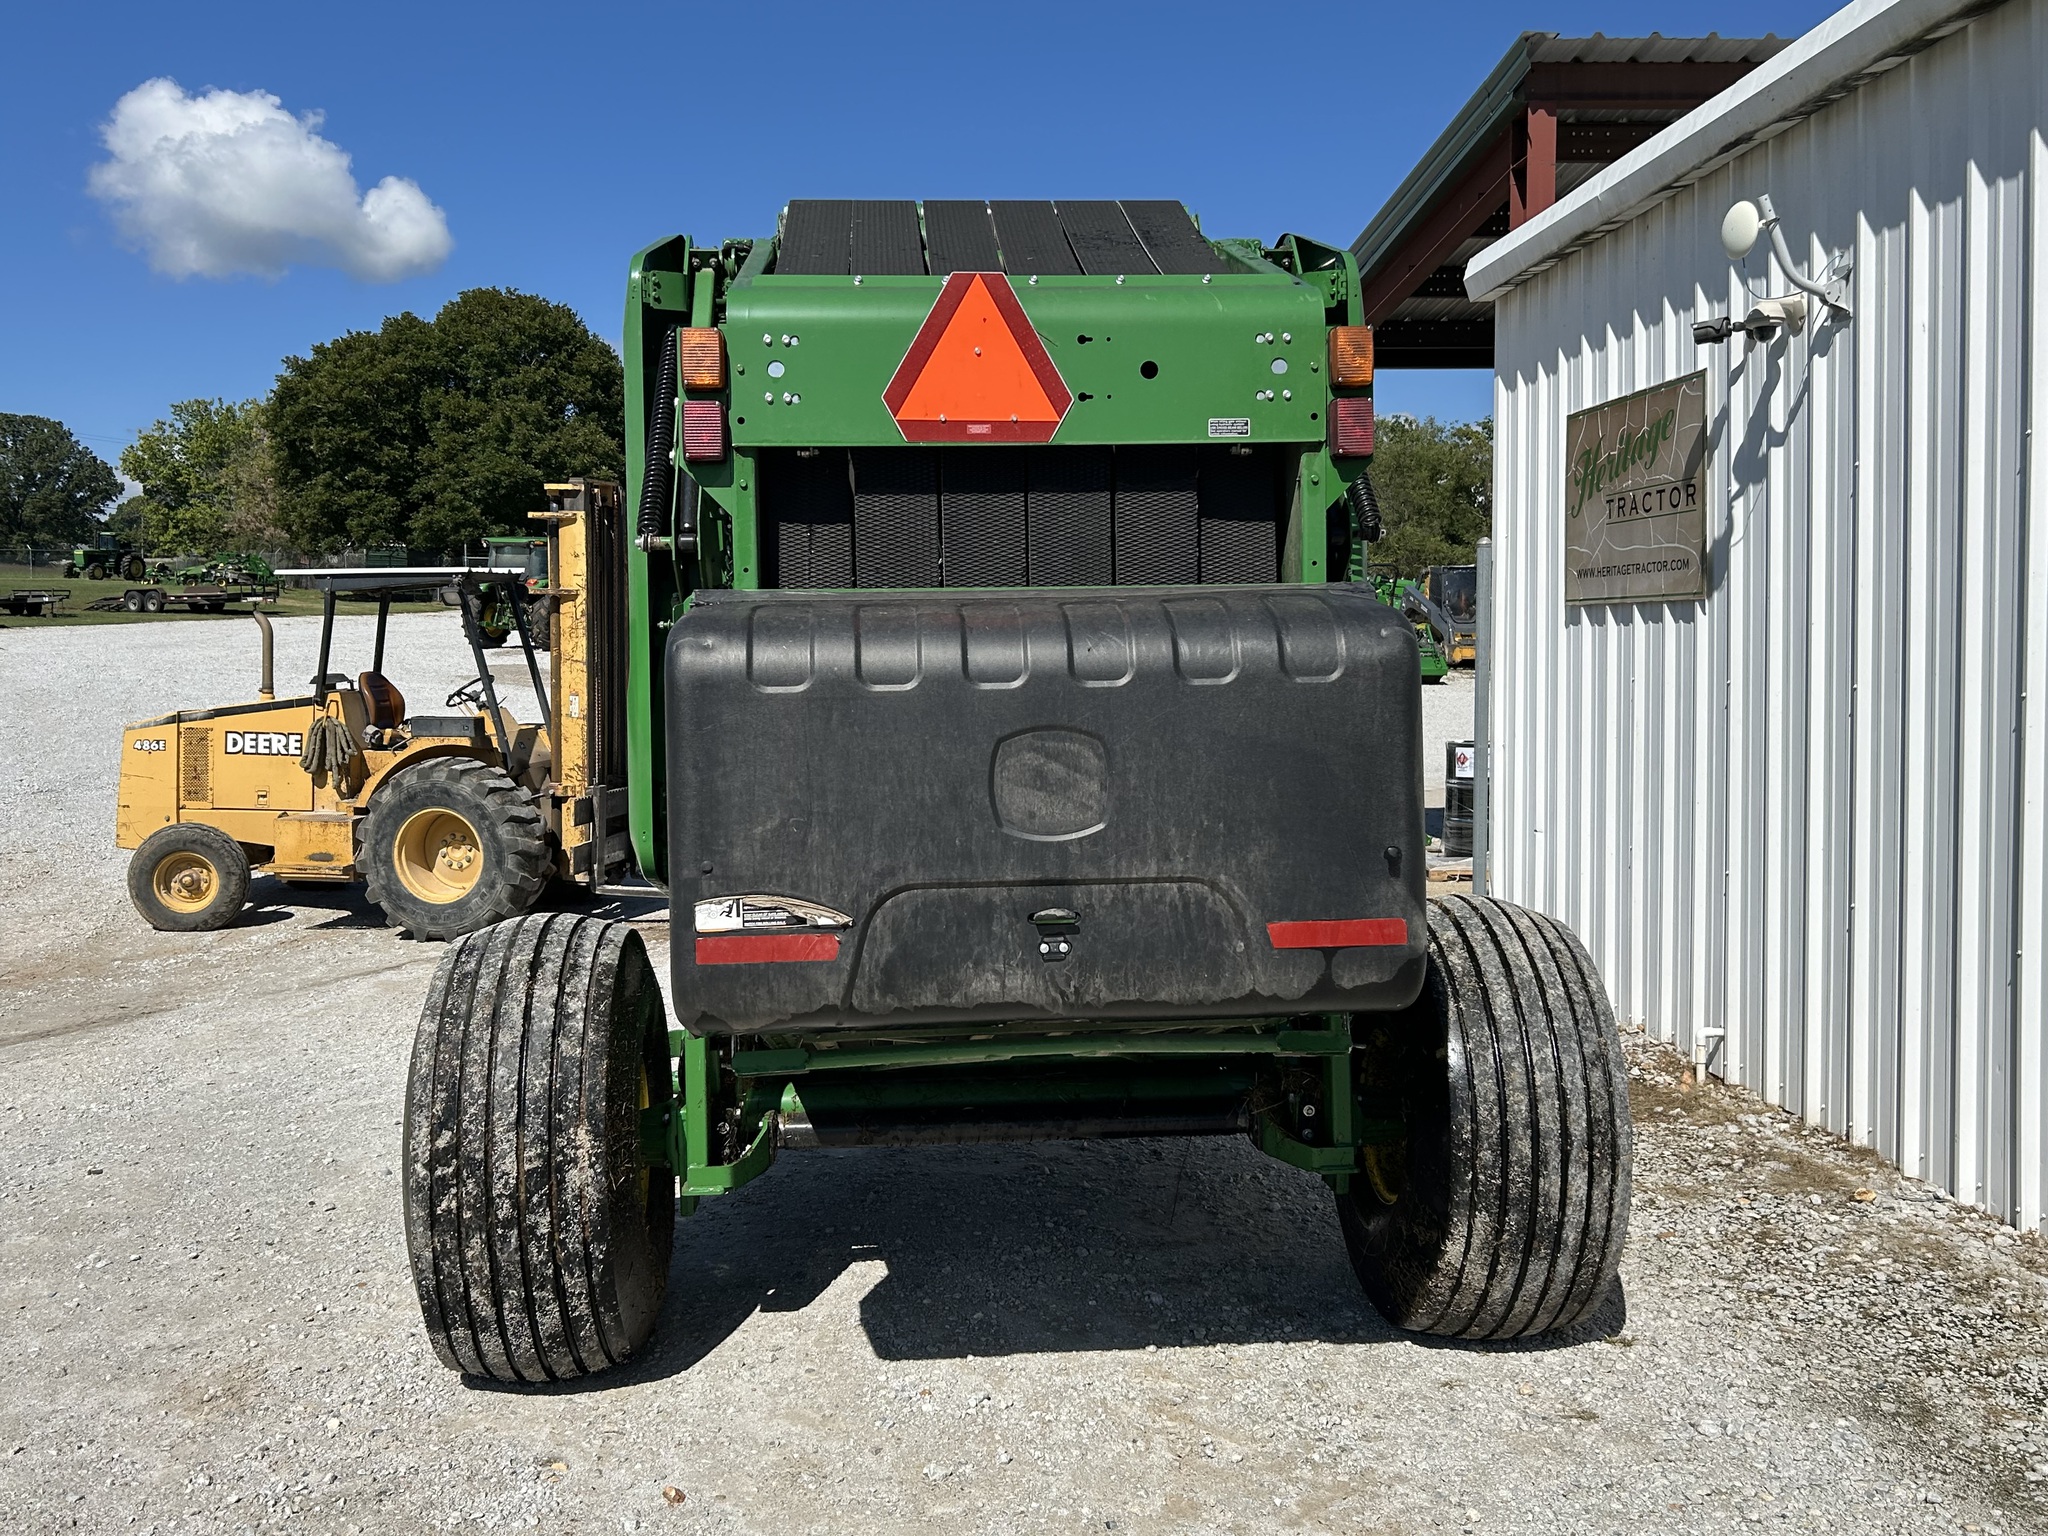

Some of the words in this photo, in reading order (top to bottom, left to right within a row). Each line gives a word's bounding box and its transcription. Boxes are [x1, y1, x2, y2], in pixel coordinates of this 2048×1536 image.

[1571, 408, 1675, 519] Heritage
[1605, 483, 1697, 520] TRACTOR
[1576, 558, 1690, 579] WWW.HERITAGETRACTOR.COM
[133, 739, 166, 751] 486E
[225, 731, 303, 756] DEERE
